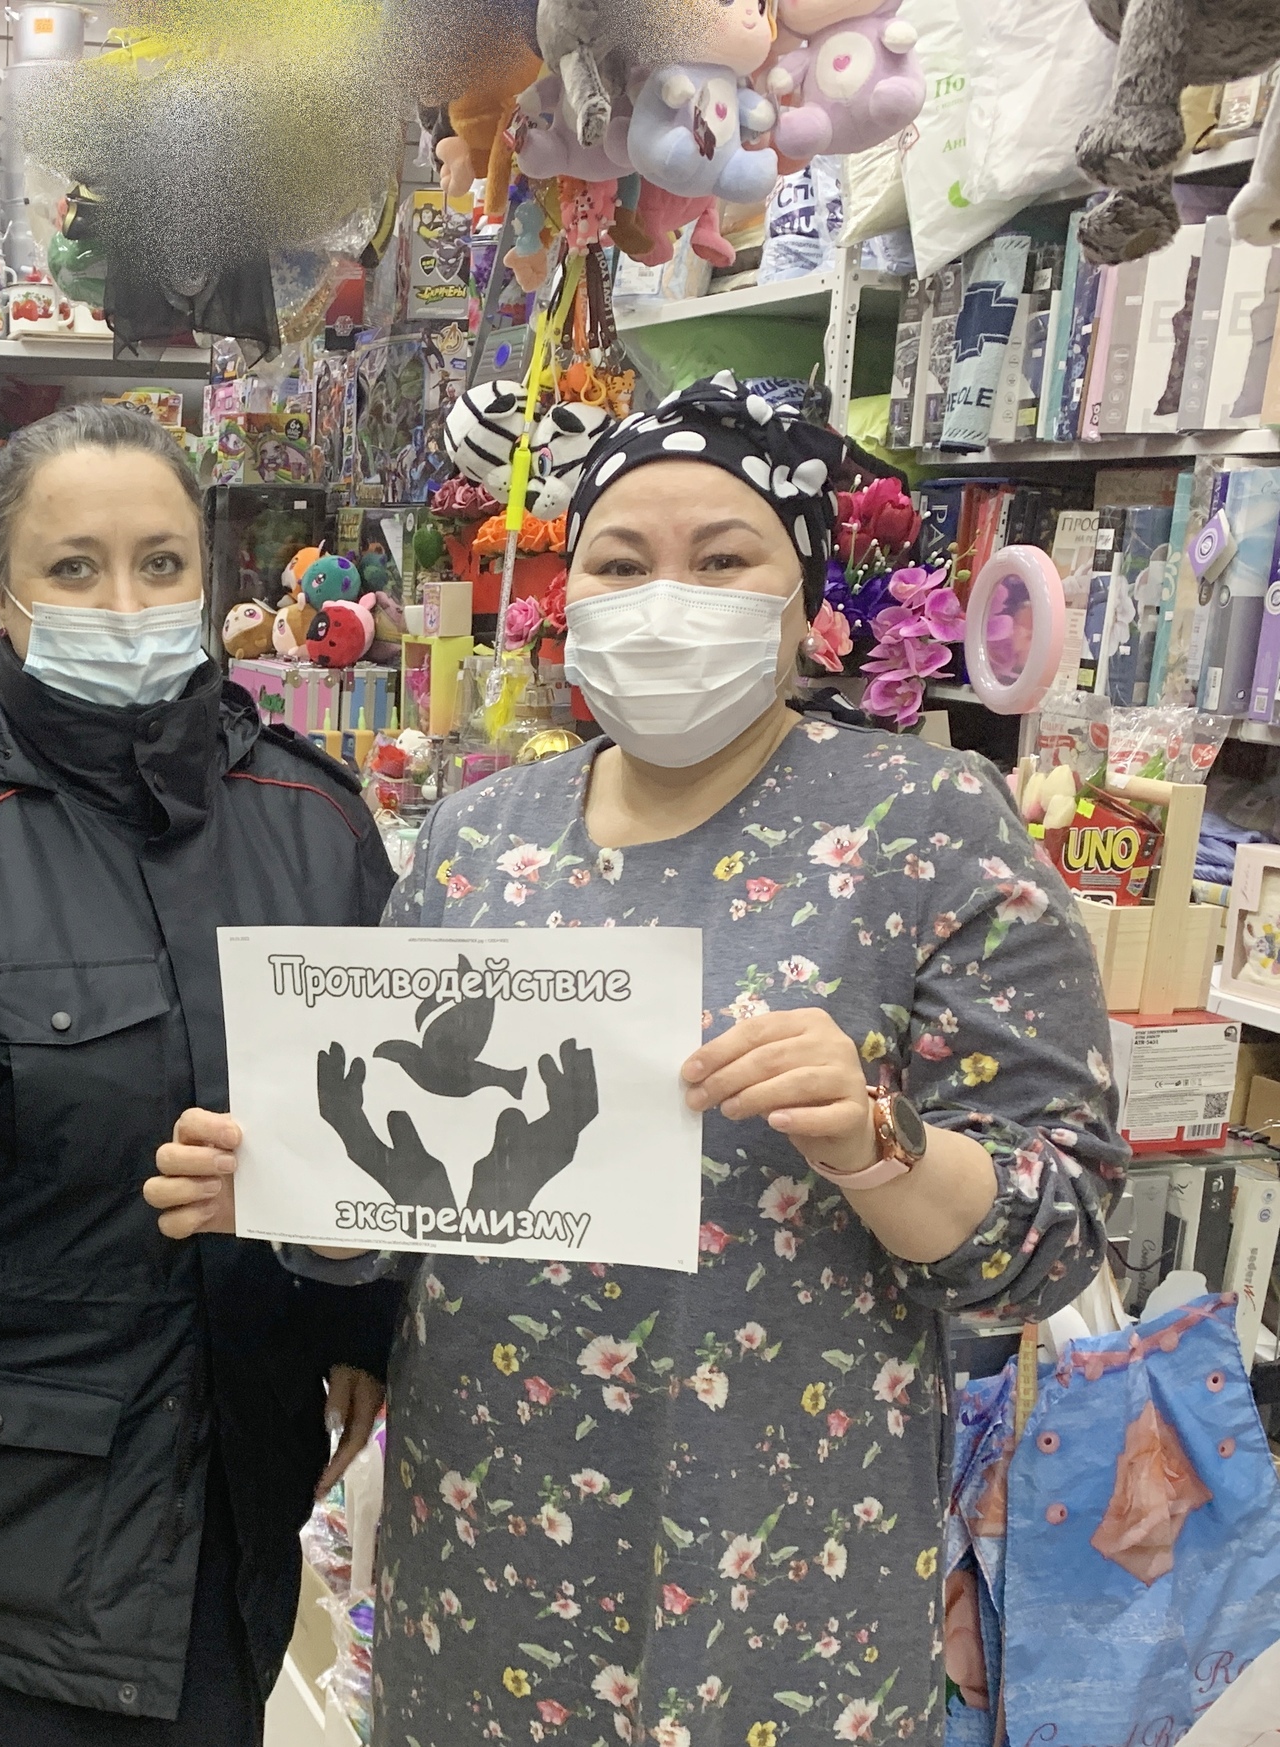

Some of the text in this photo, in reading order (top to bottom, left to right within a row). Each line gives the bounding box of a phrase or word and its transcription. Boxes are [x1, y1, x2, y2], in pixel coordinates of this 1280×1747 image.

[595, 251, 609, 279] YOU
[602, 280, 612, 311] LOVE
[1063, 827, 1140, 872] UNO
[268, 954, 631, 1007] Противодействие
[336, 1201, 591, 1249] экстремизму
